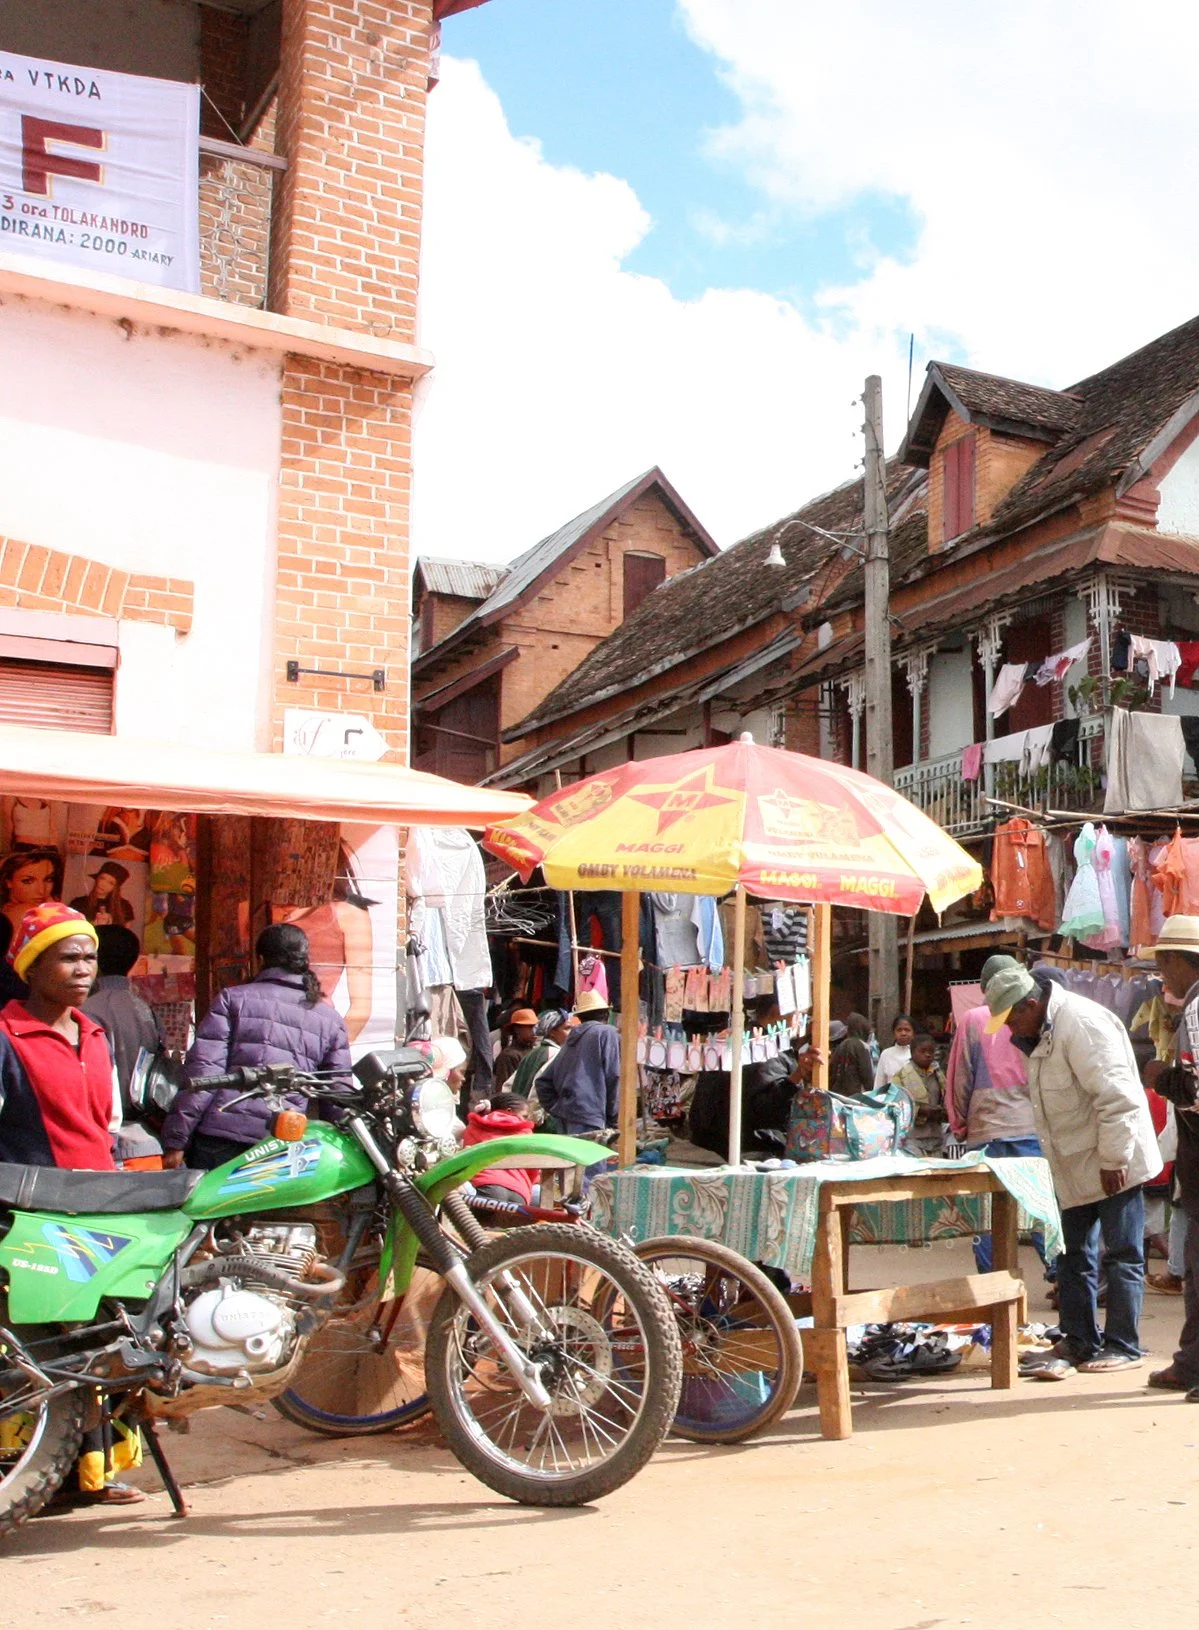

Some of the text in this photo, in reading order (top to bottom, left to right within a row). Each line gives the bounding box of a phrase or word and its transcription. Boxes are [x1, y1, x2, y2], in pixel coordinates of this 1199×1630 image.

[27, 68, 102, 101] VTKDA
[21, 114, 109, 200] F
[21, 202, 48, 218] ora
[51, 205, 149, 240] TOLAKANDRO
[0, 215, 175, 268] DIRANA: 2000 ARIARY
[615, 843, 685, 854] MAGGI
[839, 874, 896, 898] MAGGI
[244, 1138, 291, 1162] UNIST
